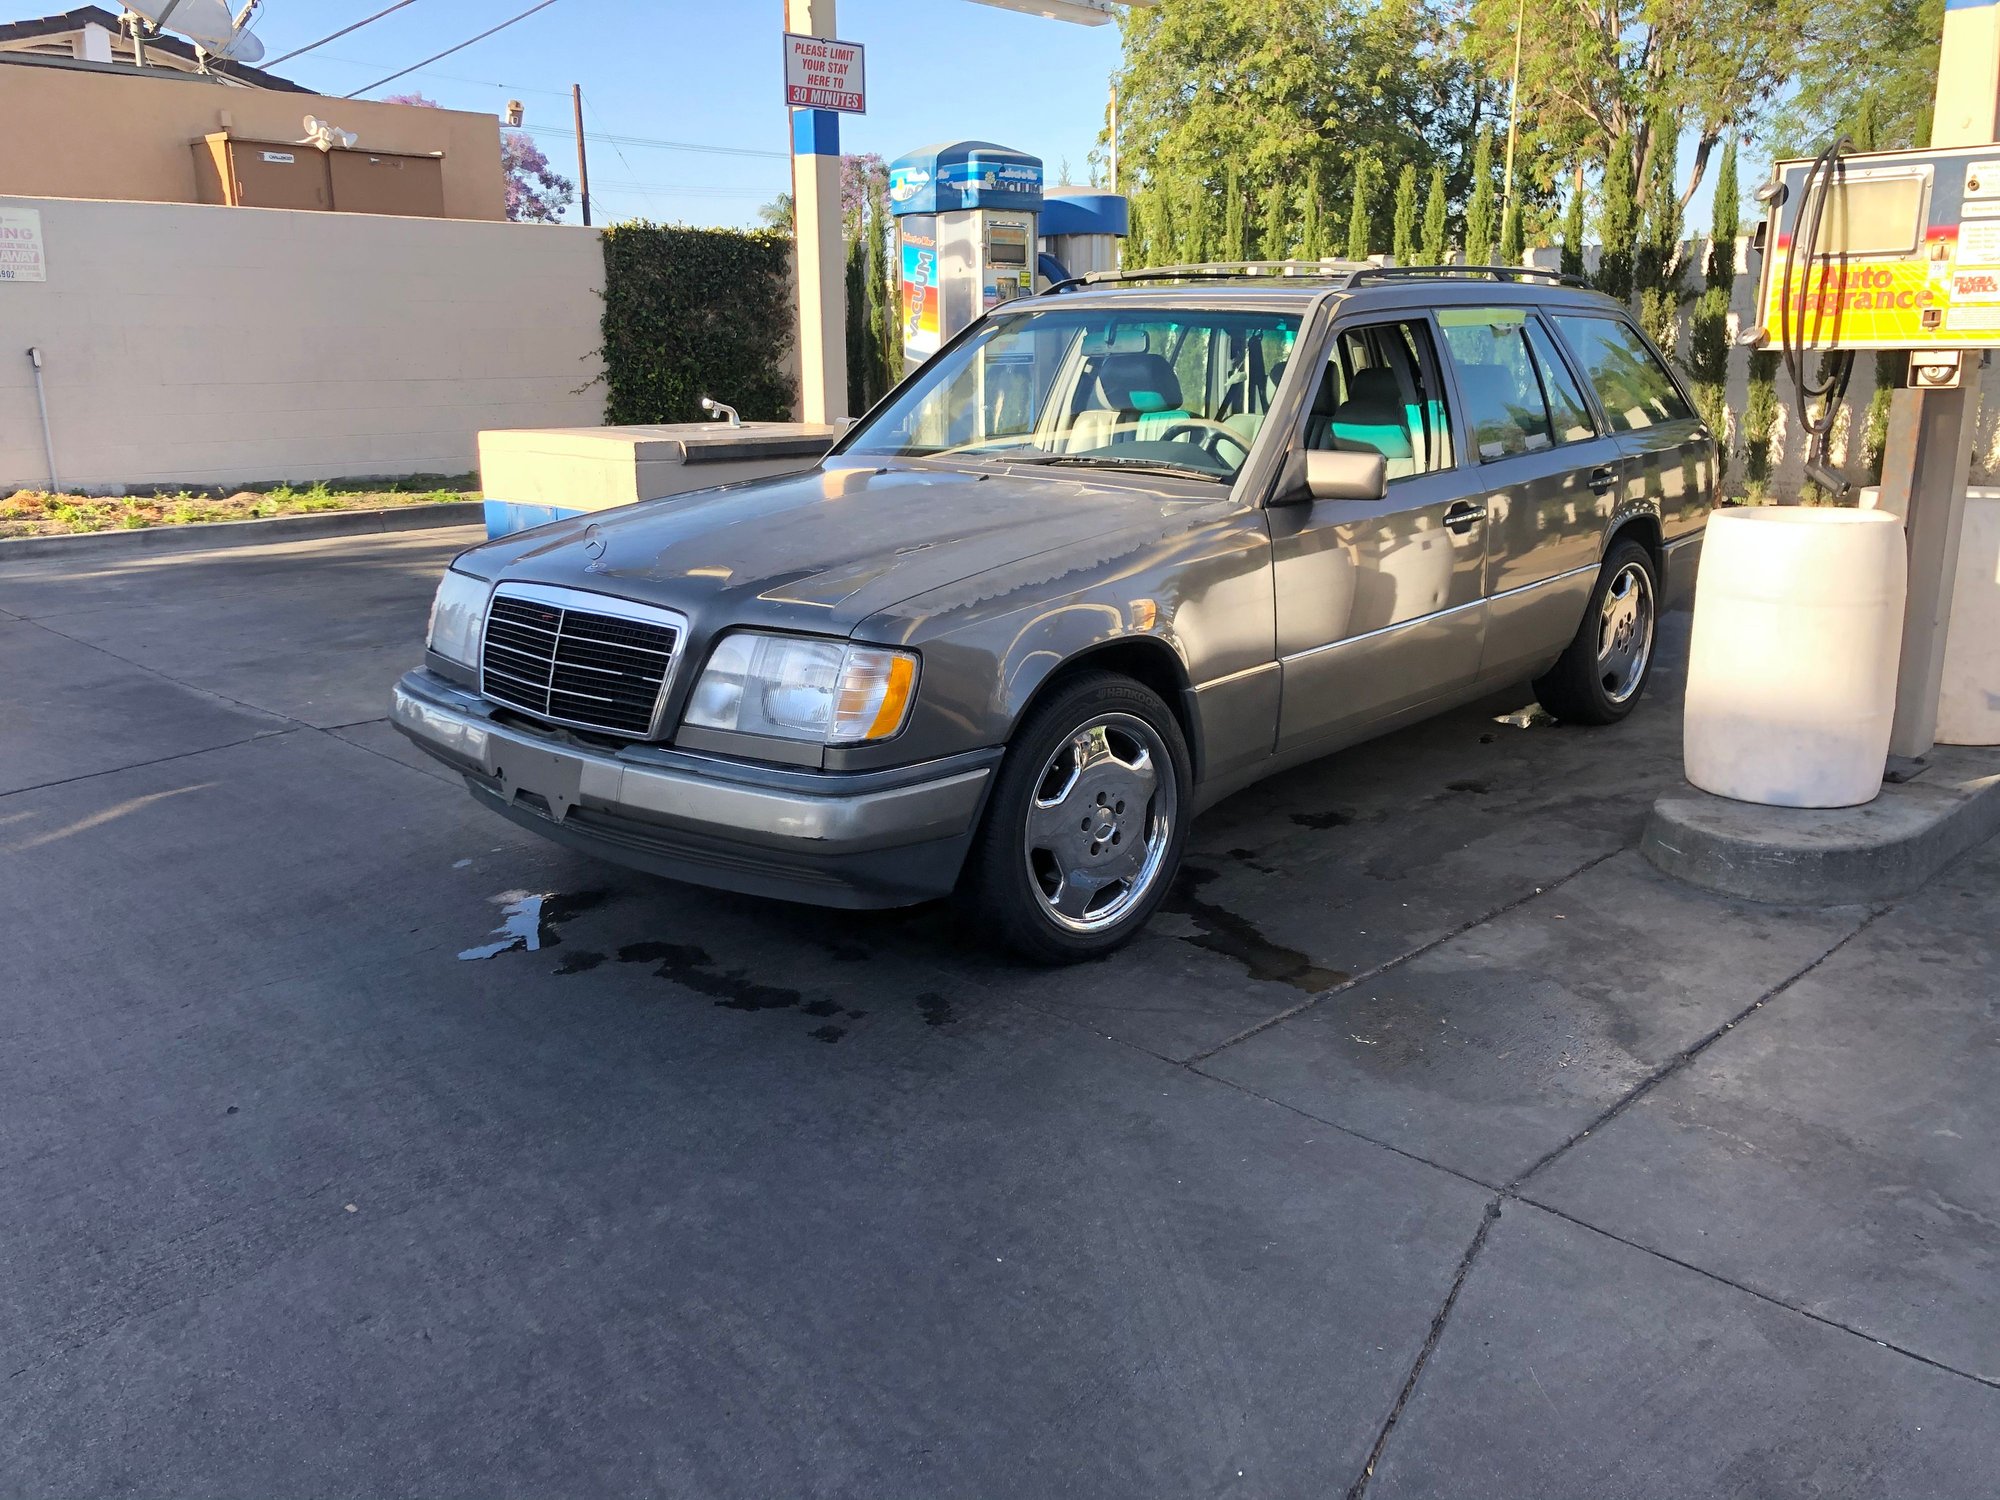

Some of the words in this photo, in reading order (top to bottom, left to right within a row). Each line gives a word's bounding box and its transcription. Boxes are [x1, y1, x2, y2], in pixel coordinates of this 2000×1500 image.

[795, 42, 828, 58] PLEASE
[829, 47, 855, 62] LIMIT
[802, 58, 826, 72] YOUR
[827, 61, 849, 76] STAY
[807, 74, 830, 87] HERE
[833, 77, 844, 89] TO
[793, 87, 807, 102] 30
[810, 89, 859, 108] MINUTES
[1816, 266, 1893, 290] Auto
[909, 250, 933, 337] VACUUM
